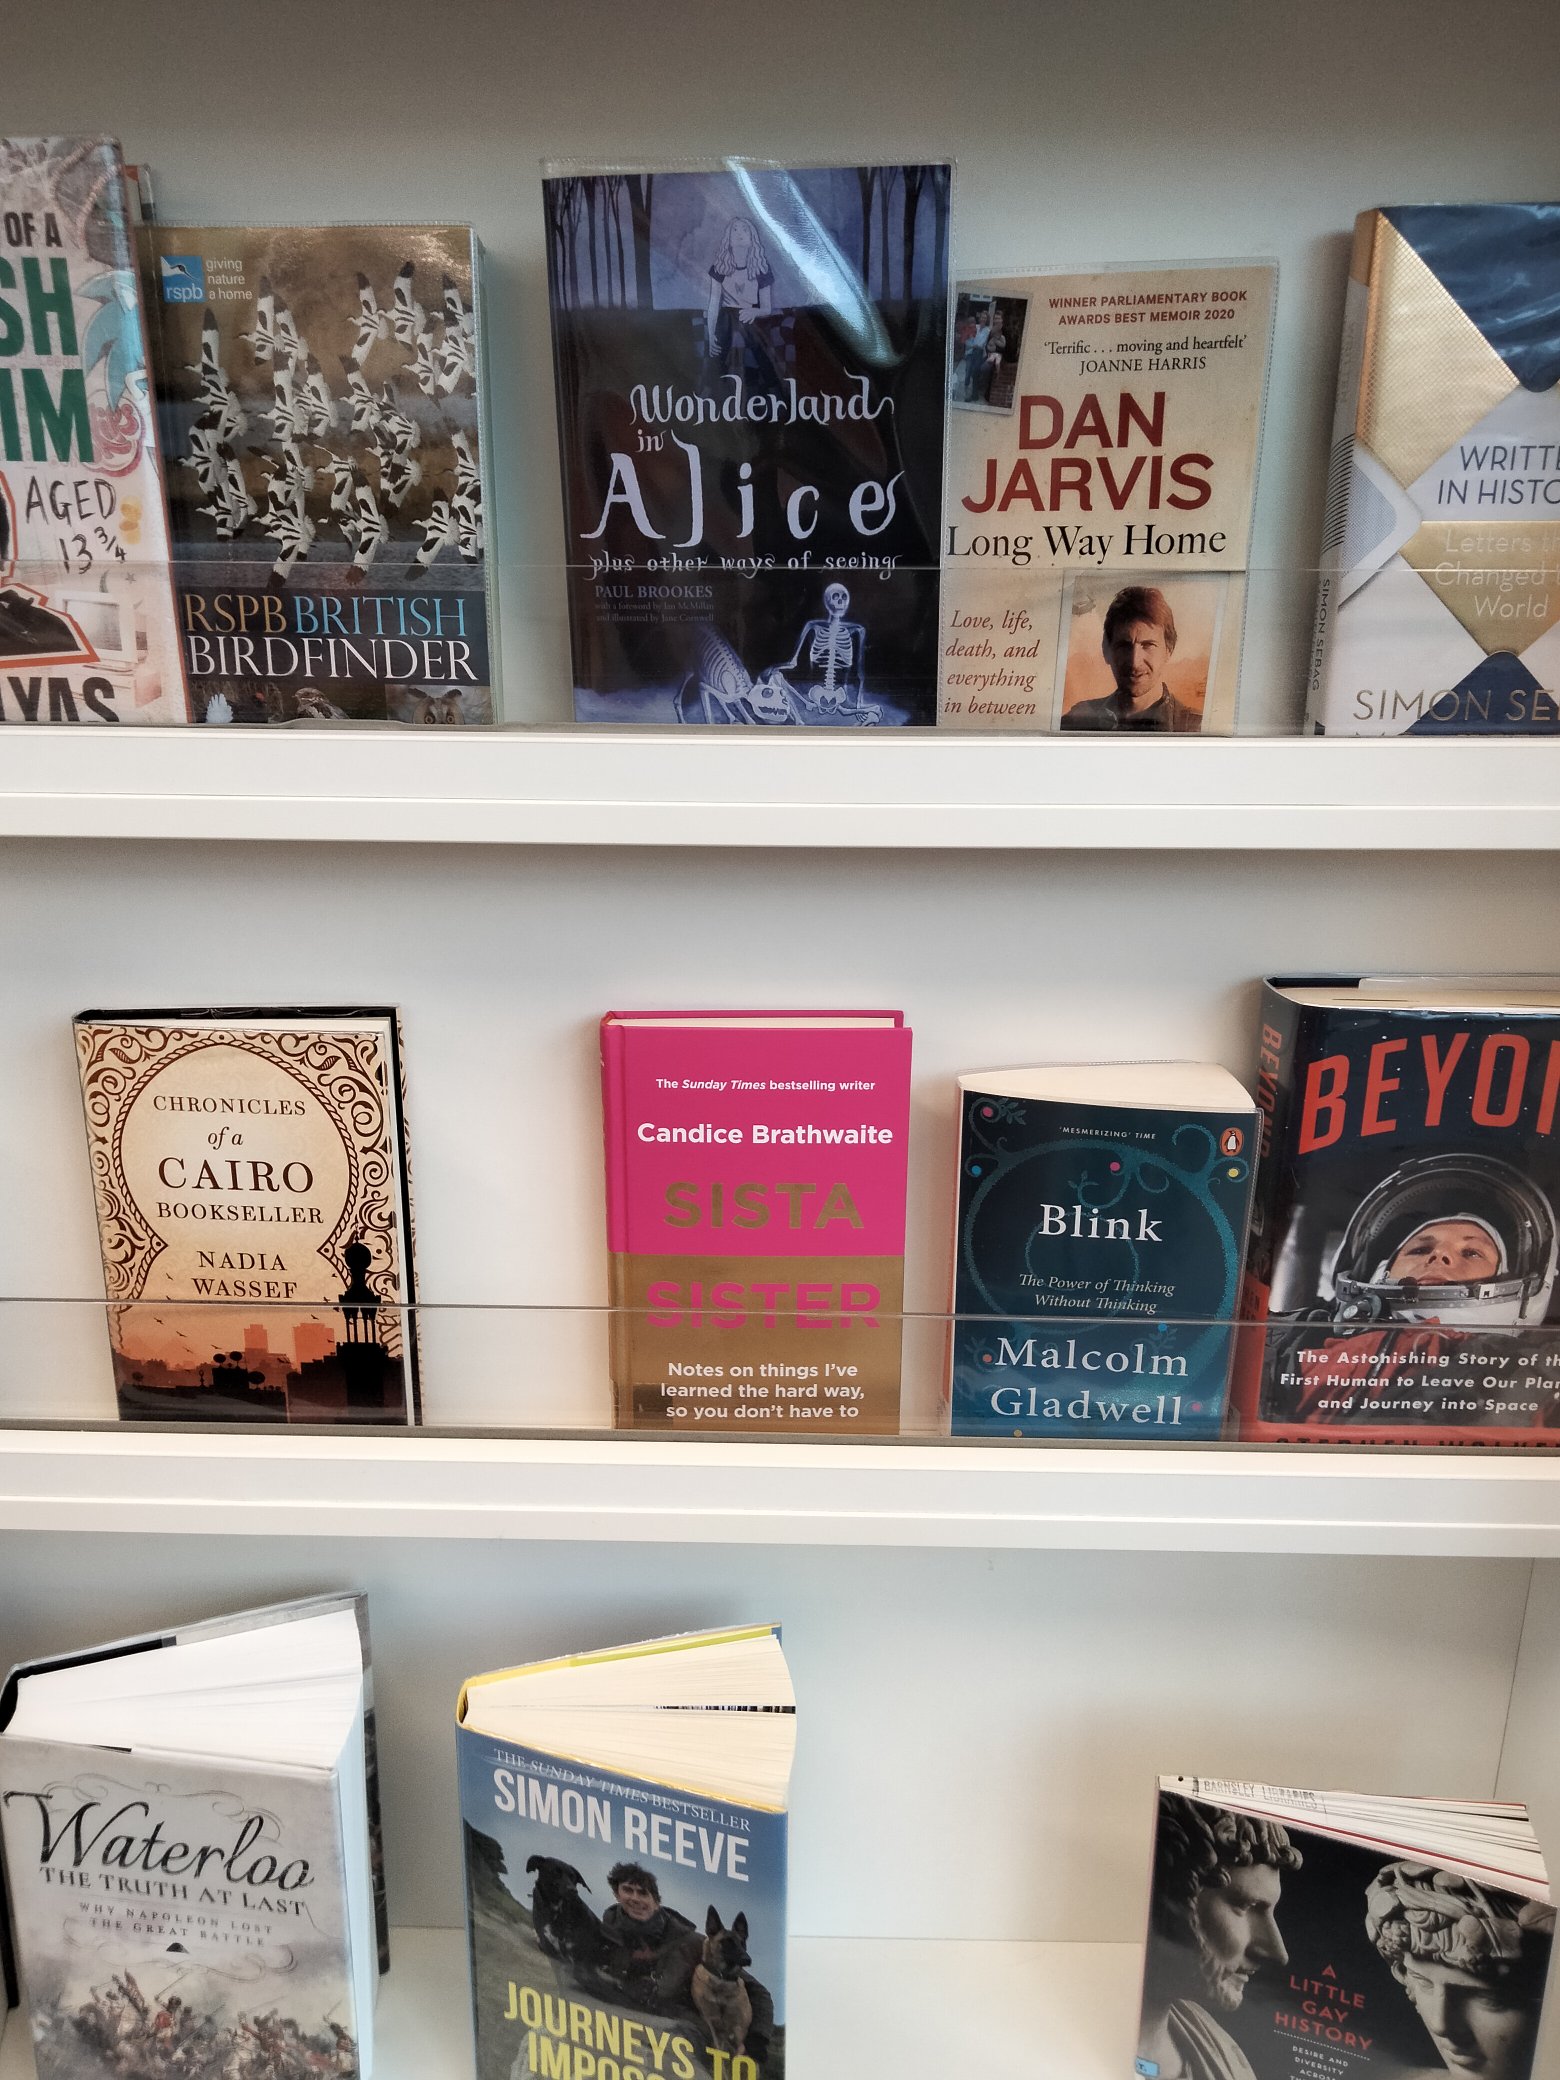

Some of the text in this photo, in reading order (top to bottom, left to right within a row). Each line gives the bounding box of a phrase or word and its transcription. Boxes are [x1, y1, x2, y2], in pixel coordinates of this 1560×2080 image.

[4, 212, 62, 247] OF A
[206, 257, 242, 272] giving
[207, 274, 245, 285] nature
[166, 283, 203, 302] rspb
[209, 288, 252, 299] a home
[1049, 290, 1247, 308] WINNER PARLIAMENTARY BOOK
[1058, 309, 1235, 325] AWARDS BEST MEMOIR 2020
[1116, 339, 1162, 355] moving
[1166, 337, 1189, 351] and
[1079, 356, 1206, 376] JOANNE HARRIS
[630, 367, 895, 425] Wonderland
[1018, 391, 1166, 450] DAN
[637, 429, 666, 452] in
[580, 429, 905, 547] Alice
[961, 453, 1215, 513] JARVIS
[1437, 479, 1469, 505] IN
[26, 475, 116, 527] AGED
[948, 524, 1227, 566] Long Way Home
[1445, 528, 1532, 553] Letters
[583, 549, 903, 580] plus other ways of seeing
[1435, 561, 1546, 592] Changed
[595, 585, 713, 598] PAUL BROOKES
[184, 594, 467, 637] RSPB BRITISH
[1318, 578, 1330, 634] SIMON
[1474, 593, 1549, 618] World
[950, 610, 1033, 635] Love, life,
[187, 635, 479, 680] BIRDFINDER
[945, 638, 1040, 659] death, and
[1312, 639, 1324, 691] SEBAG
[947, 668, 1036, 693] everything
[944, 696, 1036, 715] in between
[1353, 689, 1492, 721] SIMON
[656, 1078, 875, 1092] The Sunday Times bestselling writer
[152, 1095, 306, 1116] CHRONICLES
[207, 1126, 244, 1150] of a
[637, 1122, 893, 1144] Candice Brathwaite
[1135, 1132, 1156, 1140] TIME
[158, 1157, 314, 1193] CAIRO
[155, 1202, 324, 1224] BOOKSELLER
[663, 1181, 865, 1230] SISTA
[1038, 1203, 1163, 1242] Blink
[196, 1250, 287, 1272] NADIA
[191, 1277, 298, 1299] WASSEF
[1019, 1273, 1176, 1298] The Power of Thinking
[646, 1281, 881, 1329] SISTER
[1035, 1294, 1157, 1315] Without Thinking
[994, 1336, 1189, 1377] Malcolm
[1297, 1351, 1329, 1364] The
[1337, 1352, 1450, 1367] Astonishing
[1458, 1353, 1510, 1368] Story
[1518, 1354, 1539, 1367] of
[668, 1362, 858, 1380] Notes on things I’ve
[1280, 1374, 1518, 1389] First Human to Leave Our
[660, 1382, 865, 1400] learned the hard way,
[666, 1404, 859, 1420] so you don’t have to
[990, 1387, 1182, 1425] Gladwell
[1318, 1397, 1539, 1414] and Journey into Space
[493, 1748, 751, 1832] THE SUNDAY TIMES BESTSELLER
[1204, 1781, 1255, 1797] BARNSLEY
[493, 1768, 750, 1882] SIMON REEVE
[3, 1790, 315, 1891] Waterloo
[39, 1866, 306, 1916] THE TRUTH AT LAST
[79, 1902, 115, 1916] WHY
[126, 1908, 219, 1928] NAPOLEON
[89, 1917, 265, 1947] THE GREAT BATTLE
[1322, 1964, 1336, 1979] A
[1289, 1975, 1365, 2009] LITTLE
[1302, 2000, 1348, 2023] GAY
[504, 1980, 758, 2080] JOURNEYS TO
[1274, 2011, 1373, 2051] HISTORY
[1292, 2045, 1349, 2067] DESIRE AND
[1294, 2056, 1344, 2075] DIVERSITY
